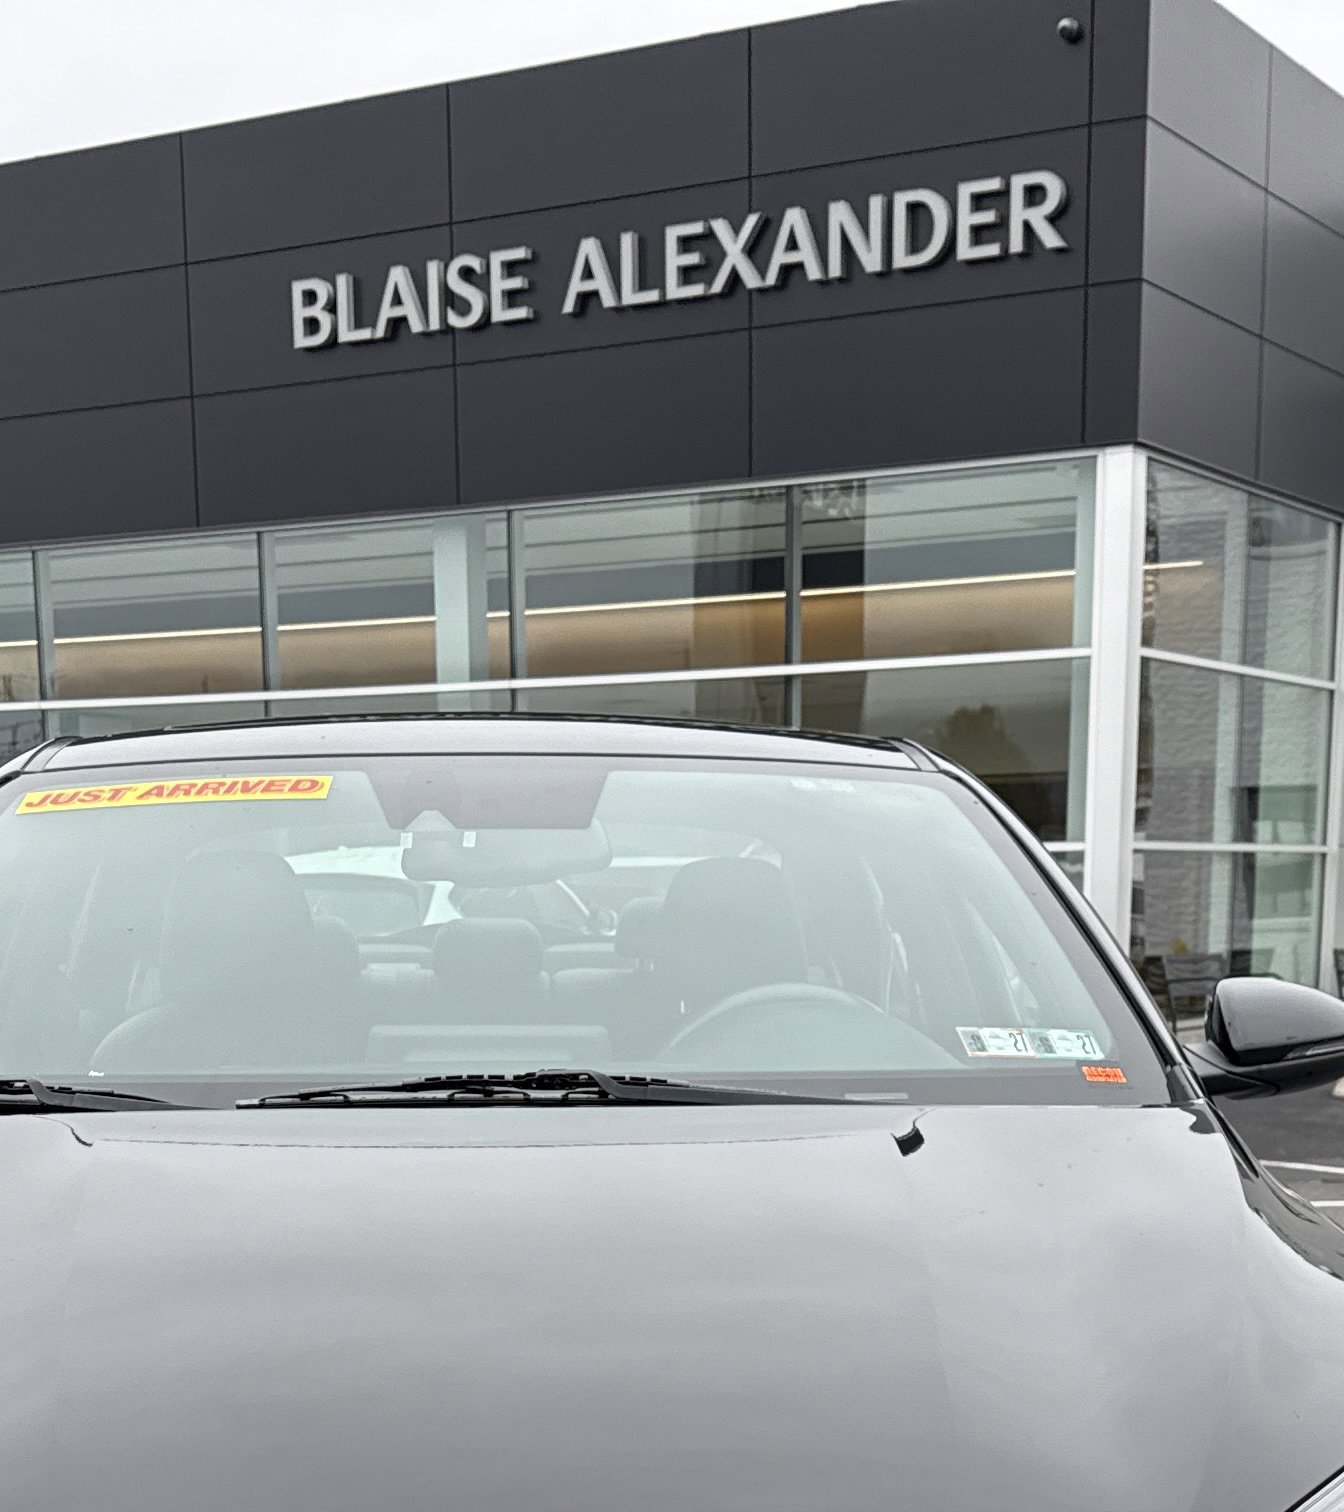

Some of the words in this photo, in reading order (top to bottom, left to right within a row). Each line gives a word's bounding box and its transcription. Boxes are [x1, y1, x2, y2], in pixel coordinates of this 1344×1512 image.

[290, 245, 535, 350] BLAISE
[559, 167, 1071, 316] ALEXANDER
[25, 786, 136, 808] JUST
[136, 778, 325, 800] ARRIVED
[1007, 1031, 1029, 1053] 27
[1076, 1033, 1098, 1056] 27
